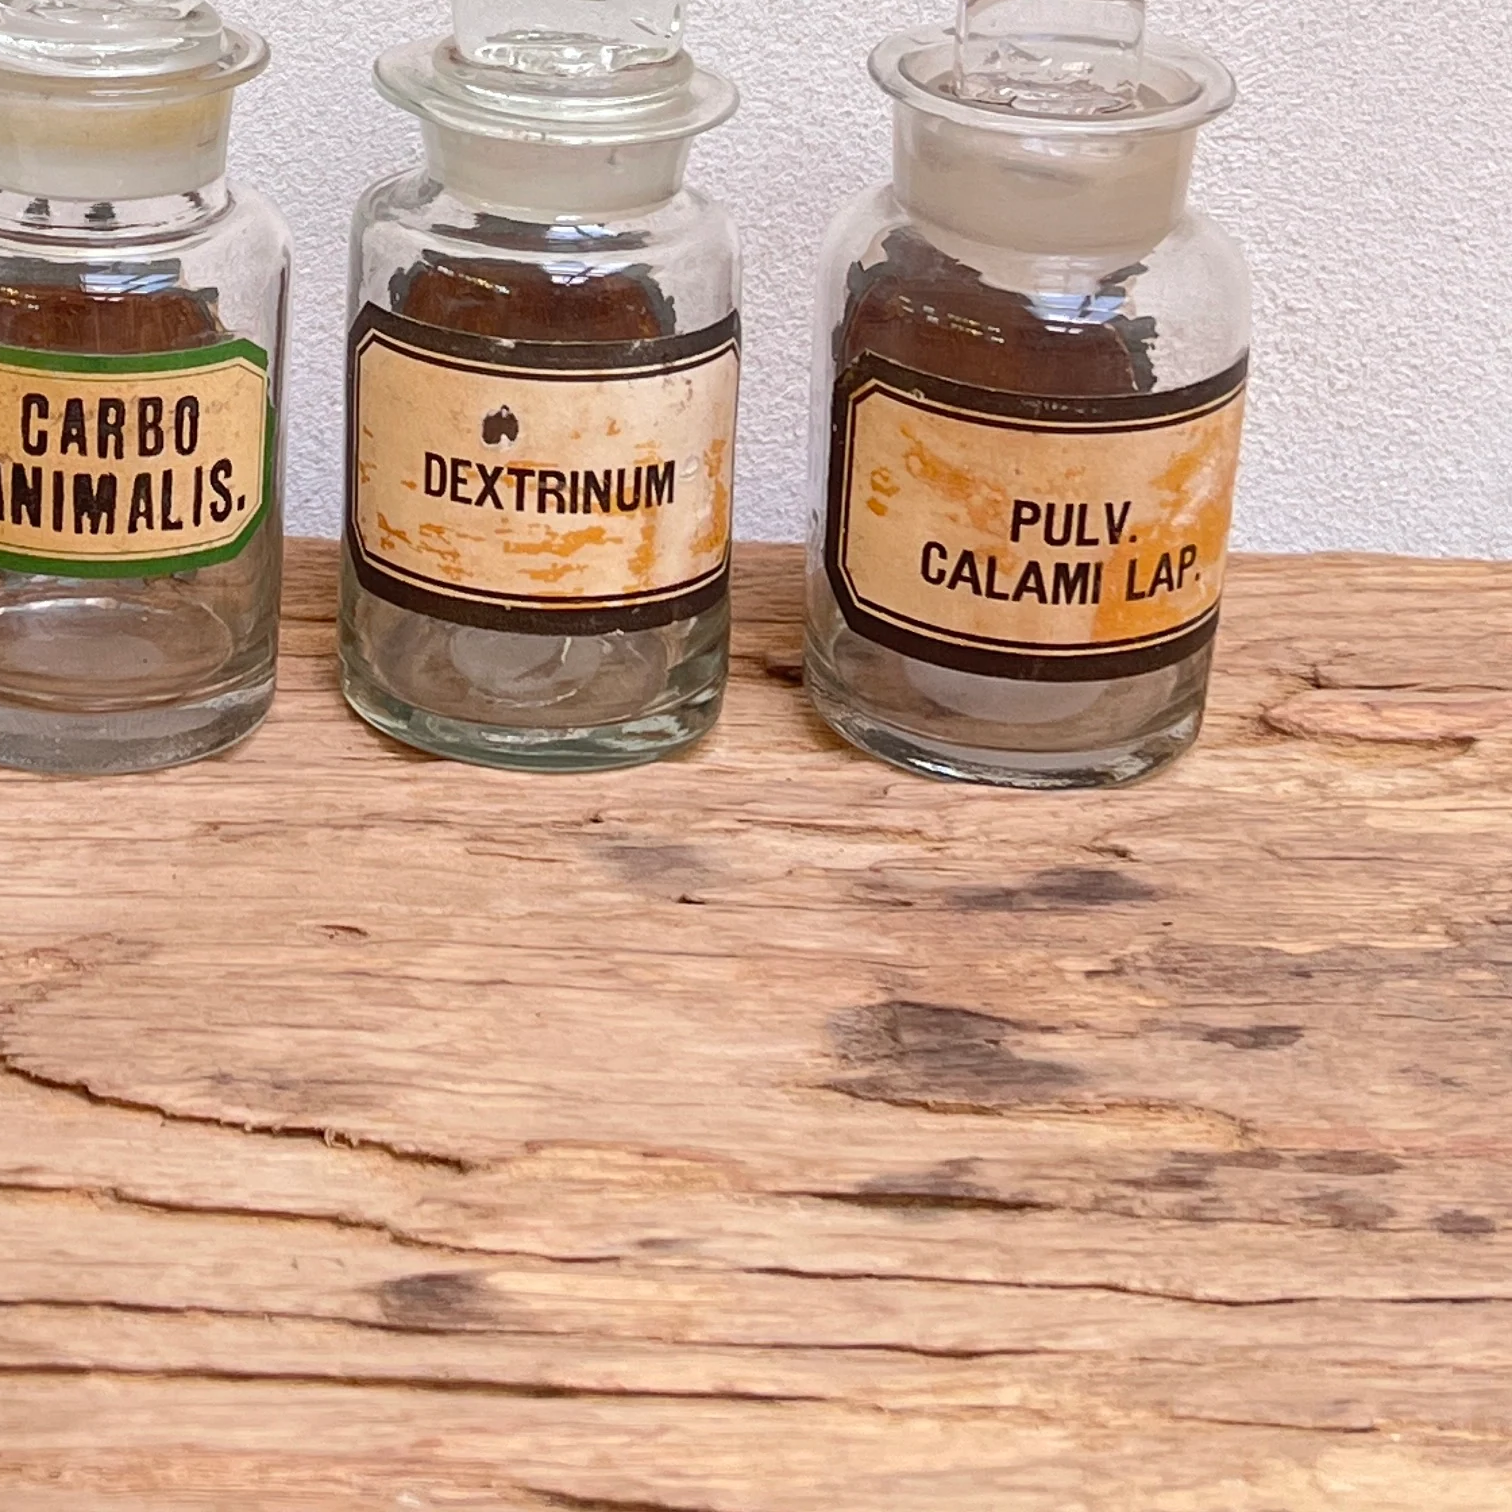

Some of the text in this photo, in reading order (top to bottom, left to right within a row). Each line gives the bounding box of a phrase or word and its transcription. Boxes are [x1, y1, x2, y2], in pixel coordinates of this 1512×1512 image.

[21, 392, 200, 459] CARBO
[424, 451, 675, 514] DEXTRINUM
[1010, 499, 1137, 546] PULV.
[920, 541, 1201, 605] CALAMI LAP.
